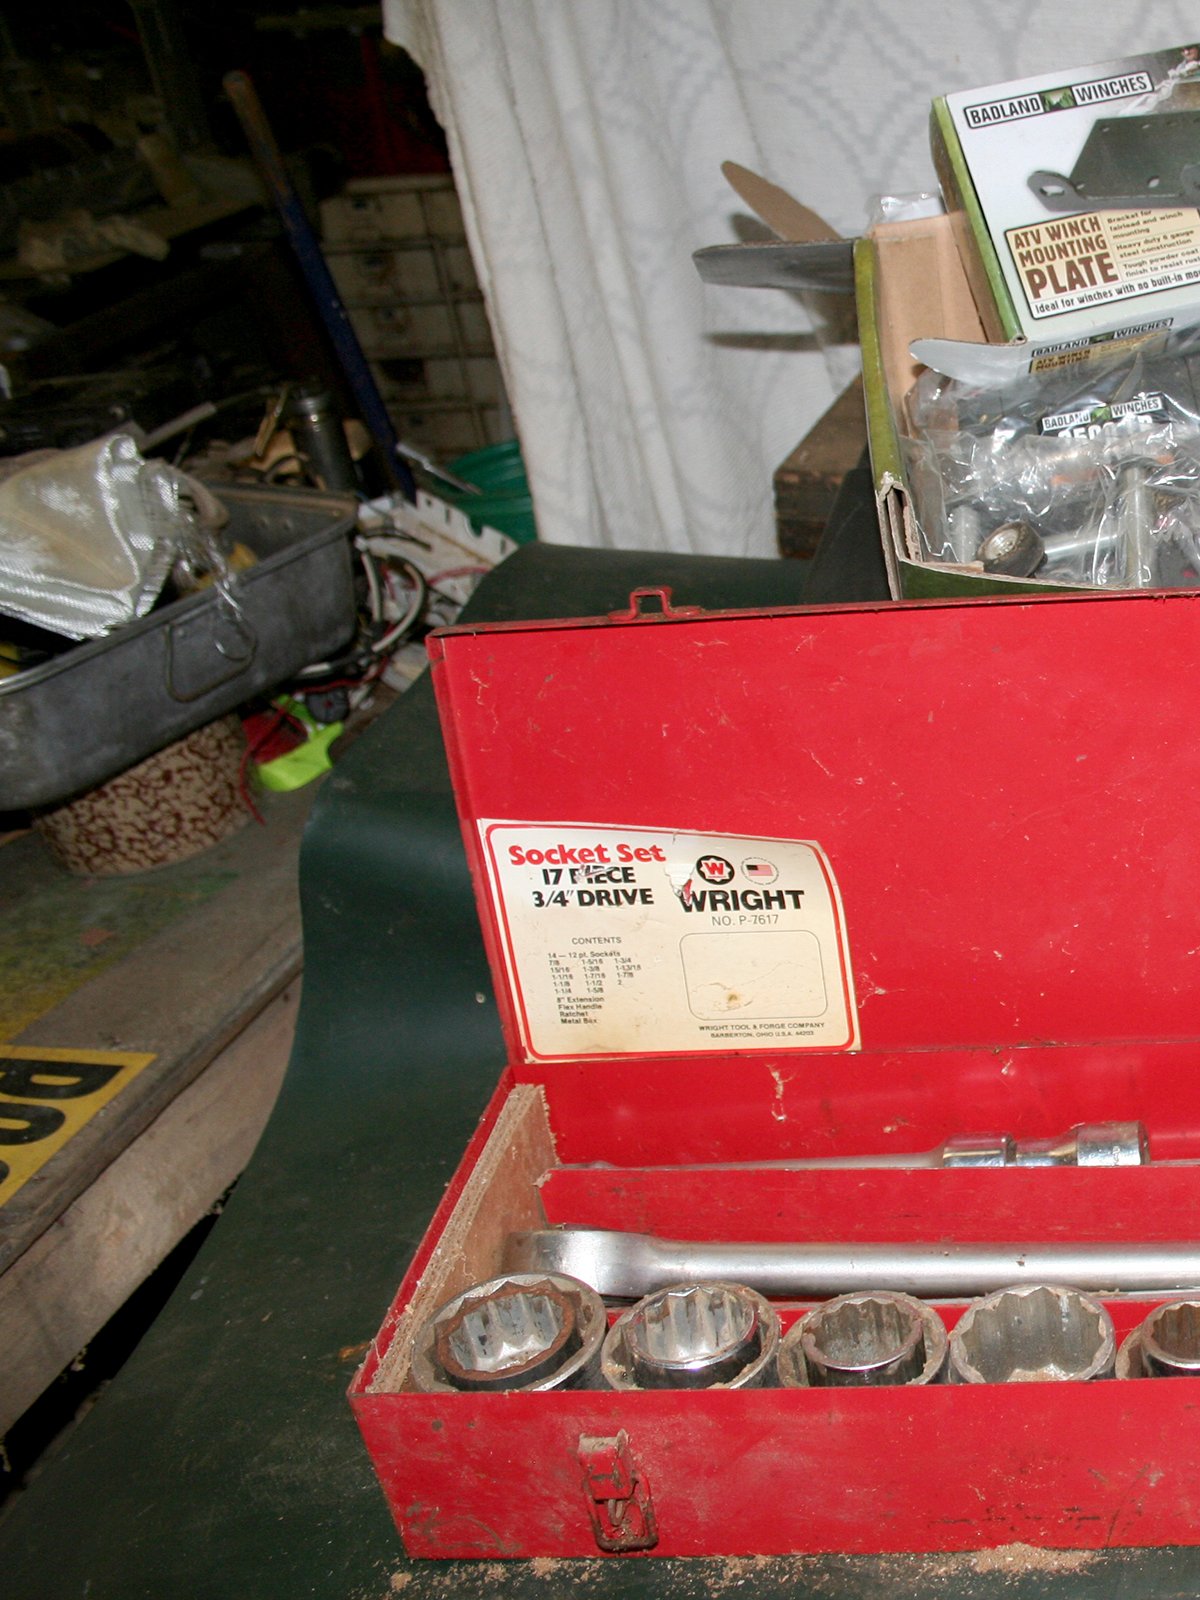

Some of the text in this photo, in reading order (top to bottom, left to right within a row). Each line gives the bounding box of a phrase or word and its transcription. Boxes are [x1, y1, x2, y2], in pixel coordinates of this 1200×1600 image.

[970, 76, 1147, 124] BADLAND WINCHES
[1107, 213, 1138, 224] Bracket
[1109, 211, 1183, 232] fairlead and winch
[1014, 216, 1102, 249] ATV WINCH
[1112, 227, 1150, 239] mounting
[1116, 241, 1141, 251] Heavy
[1143, 236, 1160, 245] duty
[1170, 230, 1194, 240] gauge
[1018, 234, 1107, 267] MOUNTING
[1119, 239, 1192, 258] steel construction
[1123, 248, 1199, 270] Tough powder coat
[1025, 252, 1119, 299] PLATE
[1125, 268, 1148, 278] finish
[1160, 260, 1183, 270] resist
[1185, 256, 1200, 265] rust
[1035, 301, 1059, 314] Ideal
[1062, 297, 1075, 308] for
[1077, 289, 1112, 304] winches
[1115, 284, 1135, 295] with
[1138, 281, 1149, 290] no
[1152, 273, 1183, 287] built-in
[1035, 338, 1089, 355] BADLAND
[1116, 321, 1169, 338] WINCHES
[1044, 413, 1089, 429] BADLAND
[1113, 399, 1160, 416] WINCHES
[508, 844, 666, 865] Socket Set
[542, 868, 563, 885] 17
[532, 888, 655, 908] 3/4" DRIVE
[680, 889, 804, 912] WRIGHT
[712, 914, 779, 926] NO. P-7617
[571, 936, 622, 945] CONTENTS
[590, 950, 621, 958] Sockets
